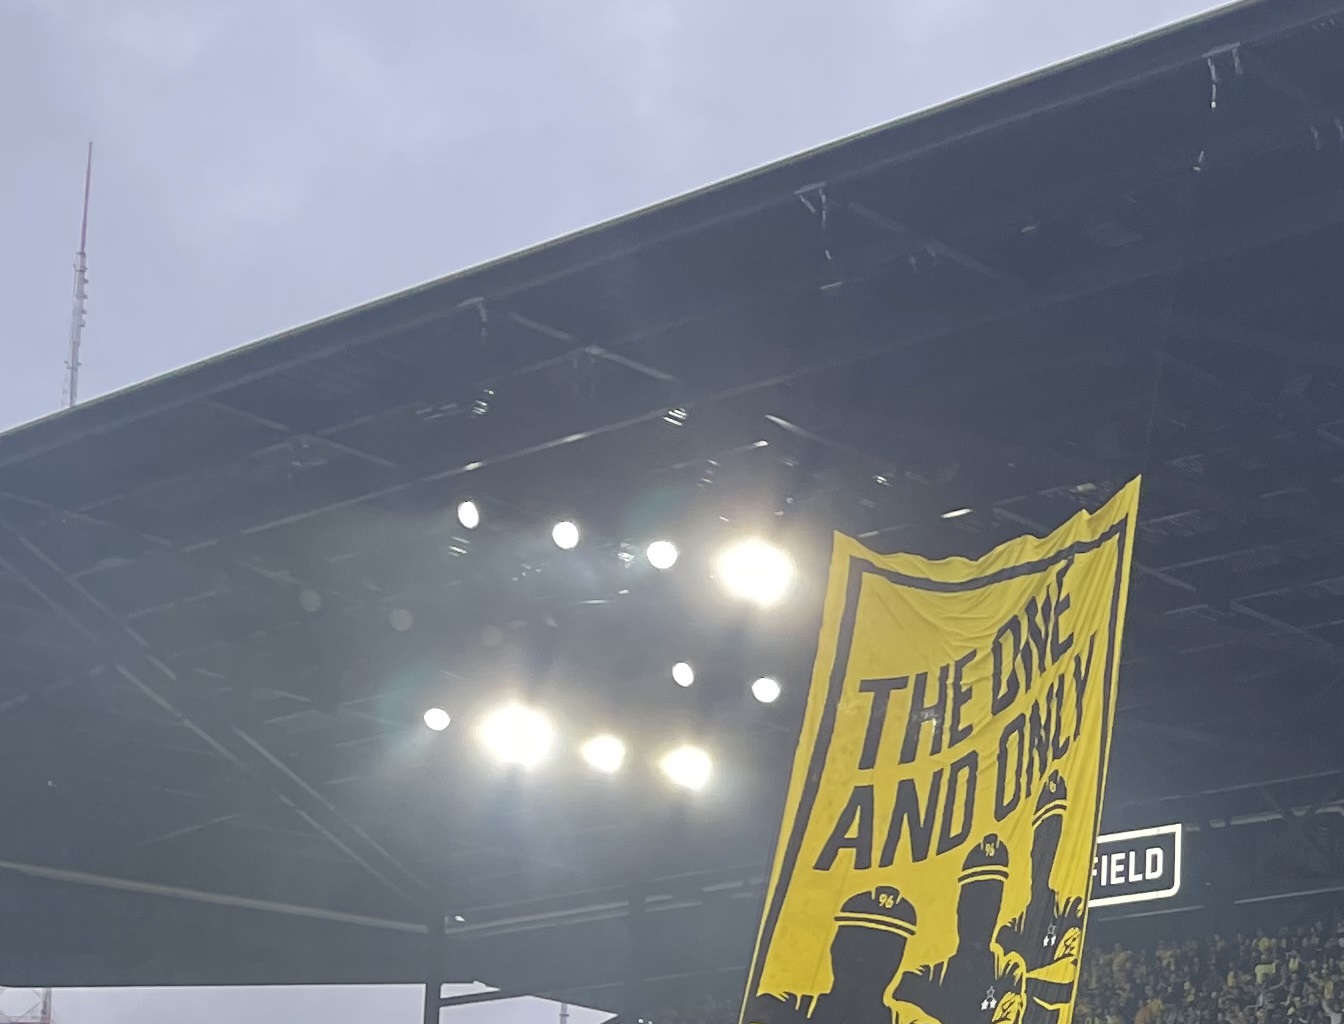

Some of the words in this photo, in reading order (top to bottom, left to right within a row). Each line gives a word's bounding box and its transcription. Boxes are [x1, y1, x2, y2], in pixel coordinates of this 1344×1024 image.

[813, 750, 979, 872] AND
[995, 632, 1097, 823] ONLY
[858, 648, 978, 770] THE
[990, 558, 1074, 716] ONE
[1092, 848, 1164, 888] IELD
